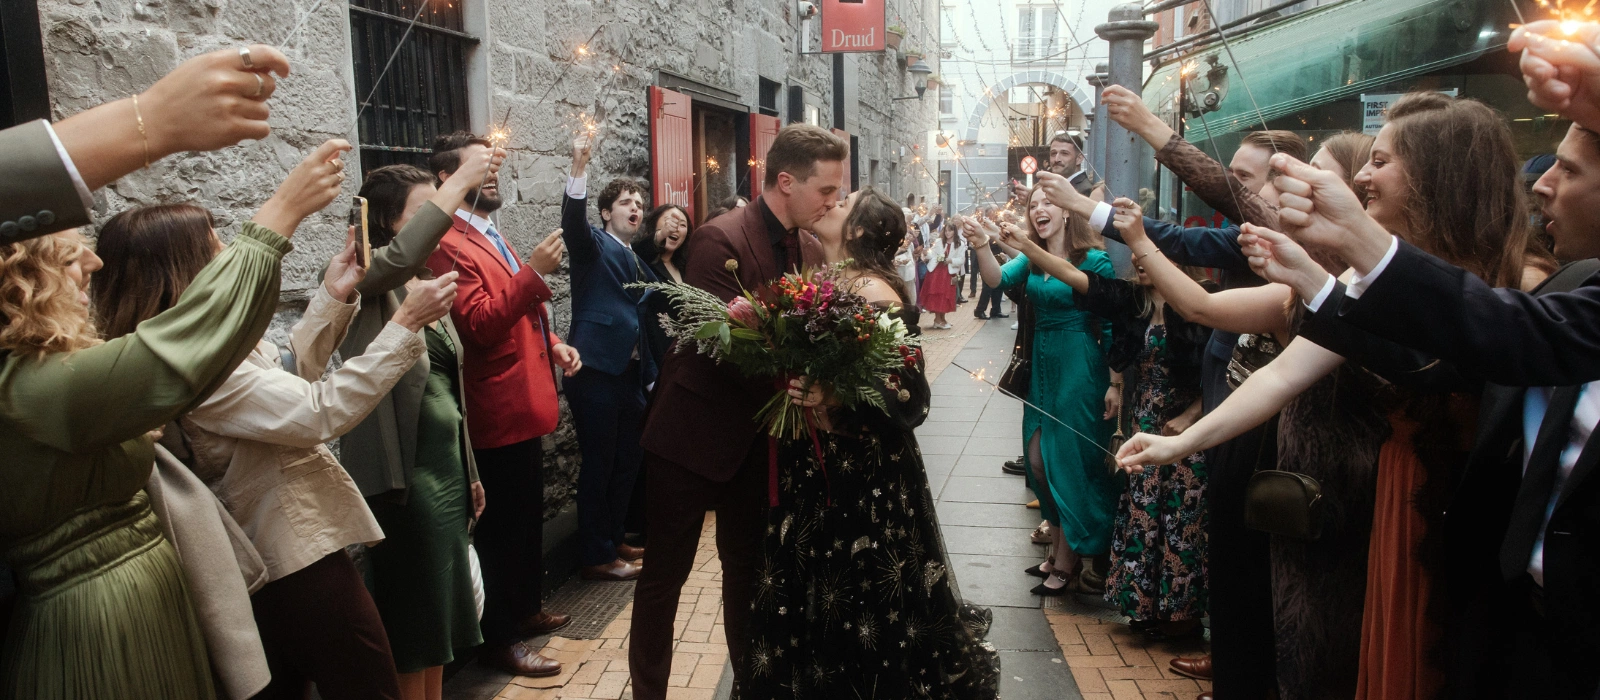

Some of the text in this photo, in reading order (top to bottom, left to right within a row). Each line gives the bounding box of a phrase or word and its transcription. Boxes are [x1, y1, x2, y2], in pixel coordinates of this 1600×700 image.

[831, 27, 875, 48] Druid
[1366, 101, 1389, 109] FIRST
[664, 180, 689, 208] Druid
